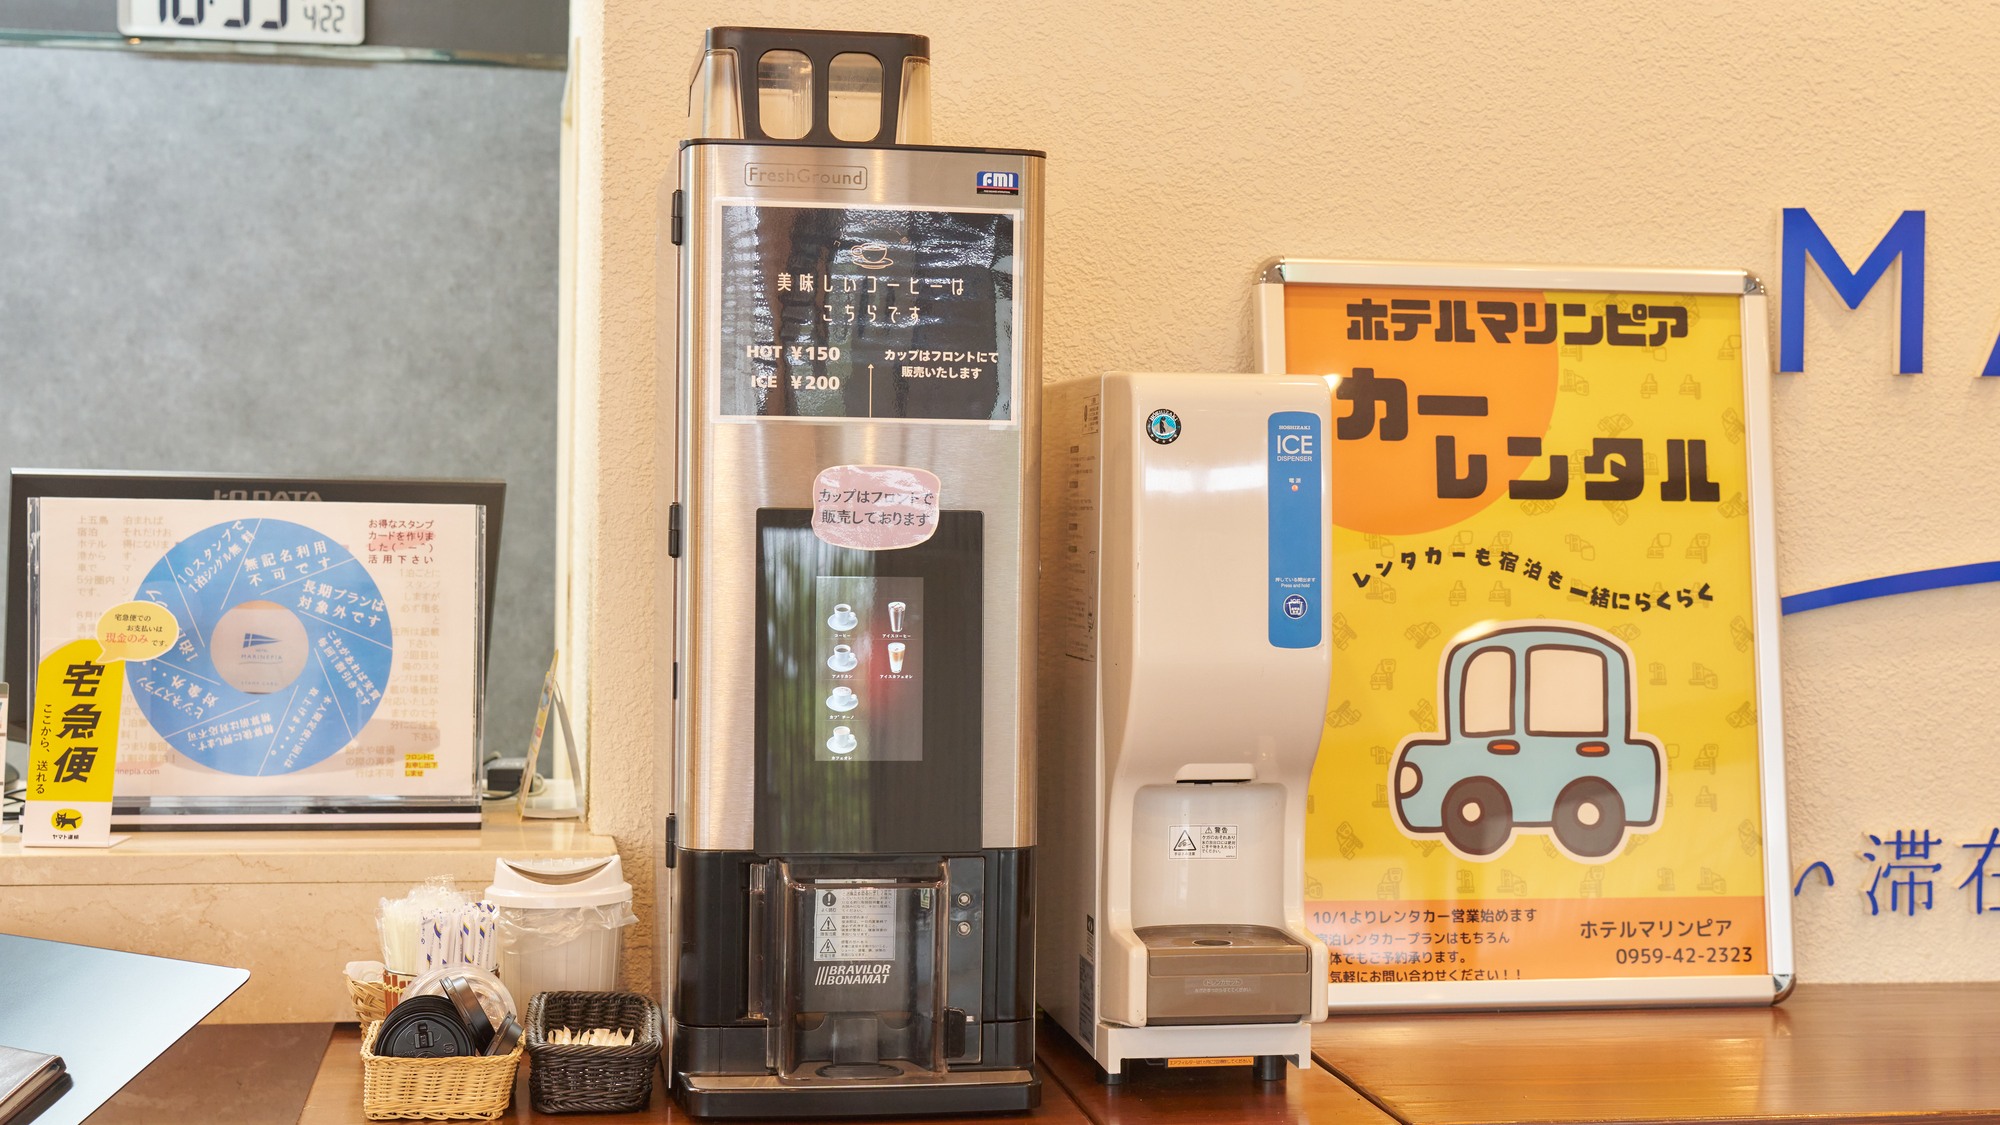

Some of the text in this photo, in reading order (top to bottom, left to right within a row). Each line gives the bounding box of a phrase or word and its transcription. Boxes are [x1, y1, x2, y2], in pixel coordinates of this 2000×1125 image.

[749, 166, 862, 185] FreshGround
[777, 272, 965, 295] 美味しいコーヒーは
[1780, 207, 2000, 376] M
[822, 303, 921, 322] こちらです
[1346, 298, 1689, 348] ホテルマリンピア
[746, 345, 782, 360] HOT
[884, 349, 999, 364] カップはフロントにて
[750, 375, 778, 389] ICE
[901, 366, 983, 380] 販売いたします
[1336, 367, 1489, 442] カー
[1277, 434, 1313, 455] ICE
[1435, 434, 1721, 503] レンタル
[818, 488, 934, 506] カップはフロントで
[368, 519, 434, 529] お得なスタンプ
[821, 509, 930, 527] 販売しております
[368, 531, 434, 541] カードを作りま
[244, 540, 328, 572] 無記名利用
[368, 554, 434, 565] 活用下さい
[248, 557, 331, 587] 不可です
[1352, 546, 1714, 612] レンタカーも宿泊も一緒にらくらく
[302, 579, 385, 612] 長期プランは
[114, 613, 152, 622] 宅急便での
[297, 595, 381, 628] 対象外です
[105, 633, 148, 644] 現金のみ
[126, 625, 163, 633] お支払いは
[53, 660, 105, 783] 宅急便
[1313, 907, 1538, 925] 10/1よりレンタカー営業始めます
[1580, 918, 1732, 940] ホテルマリンピア
[1615, 946, 1753, 965] 0959-42-2323
[829, 964, 891, 975] BRAVILOR
[827, 974, 890, 986] BONAMAT
